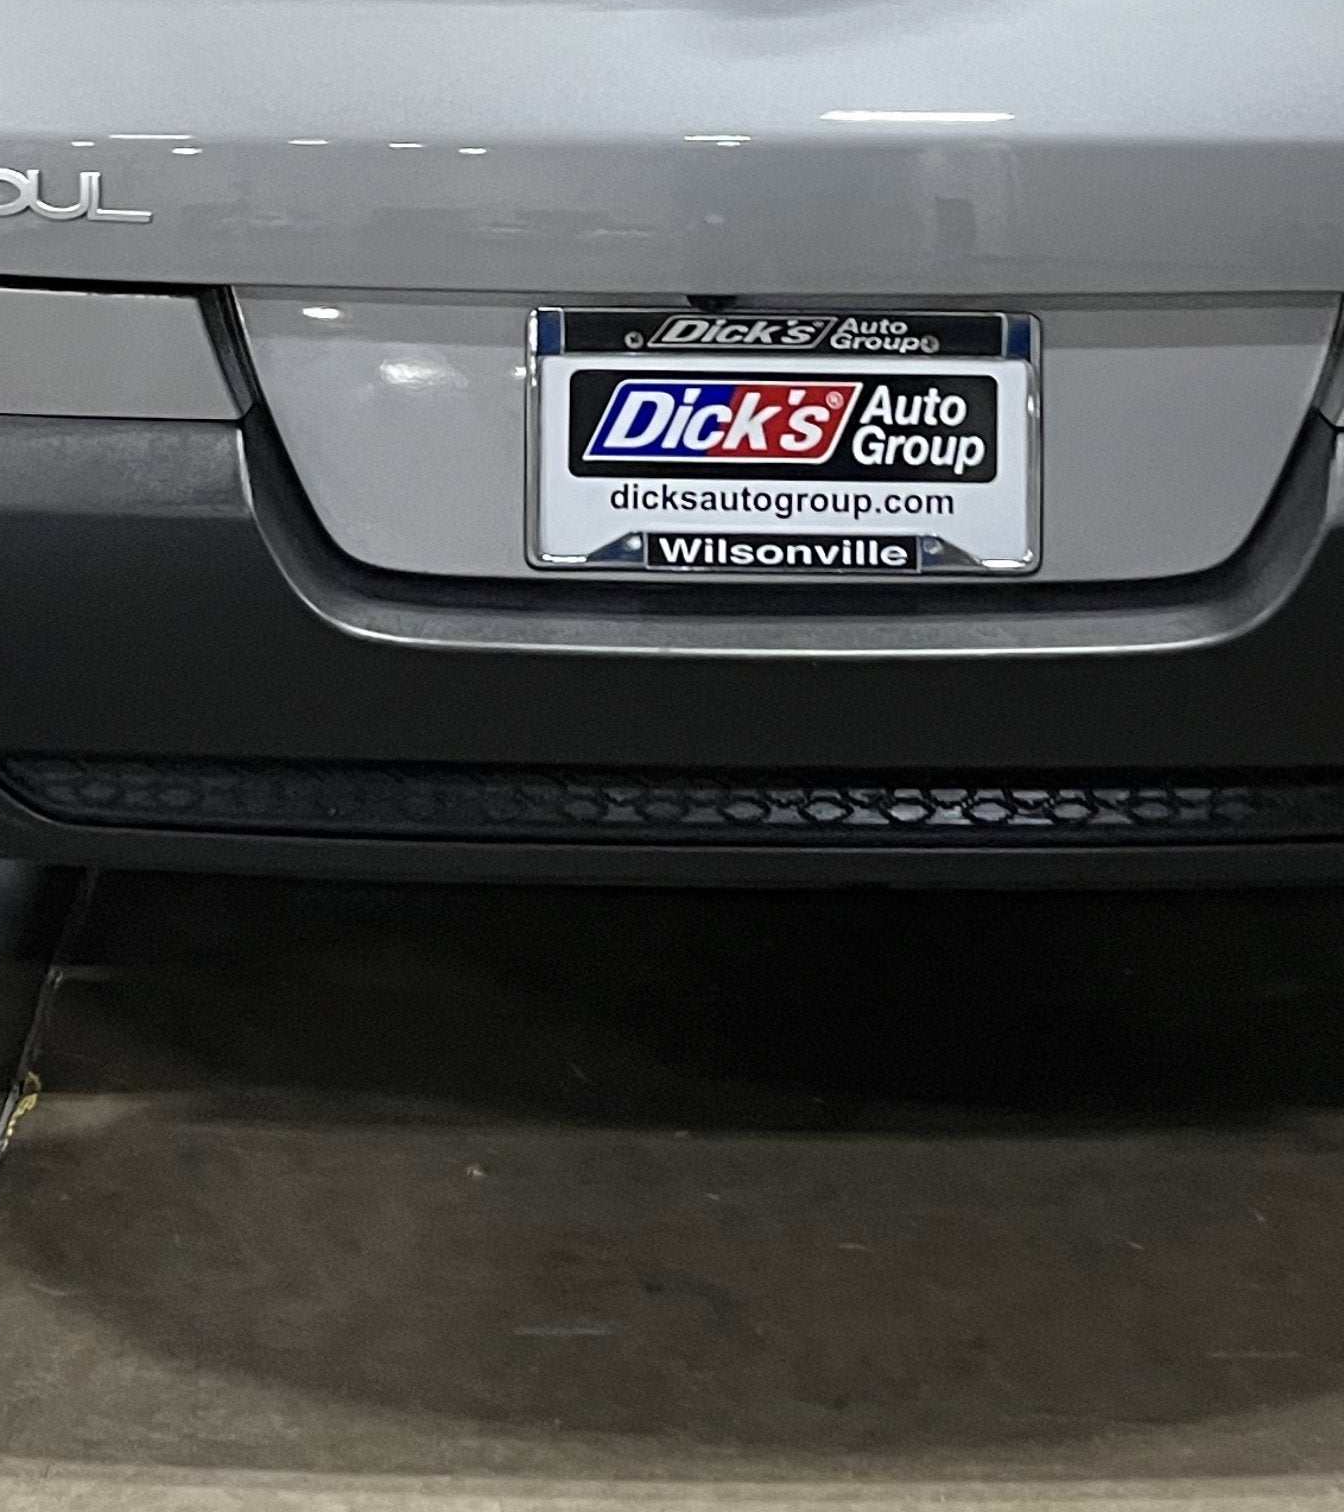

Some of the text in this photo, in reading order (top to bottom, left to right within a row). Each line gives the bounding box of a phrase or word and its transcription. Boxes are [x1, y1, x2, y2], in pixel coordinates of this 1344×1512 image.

[661, 317, 908, 344] Dick's Auto
[830, 333, 921, 353] Group
[603, 385, 967, 451] Dick's Auto
[852, 425, 986, 474] Group
[610, 484, 955, 518] dicksautogroup.com
[658, 537, 908, 566] Wilsonville
